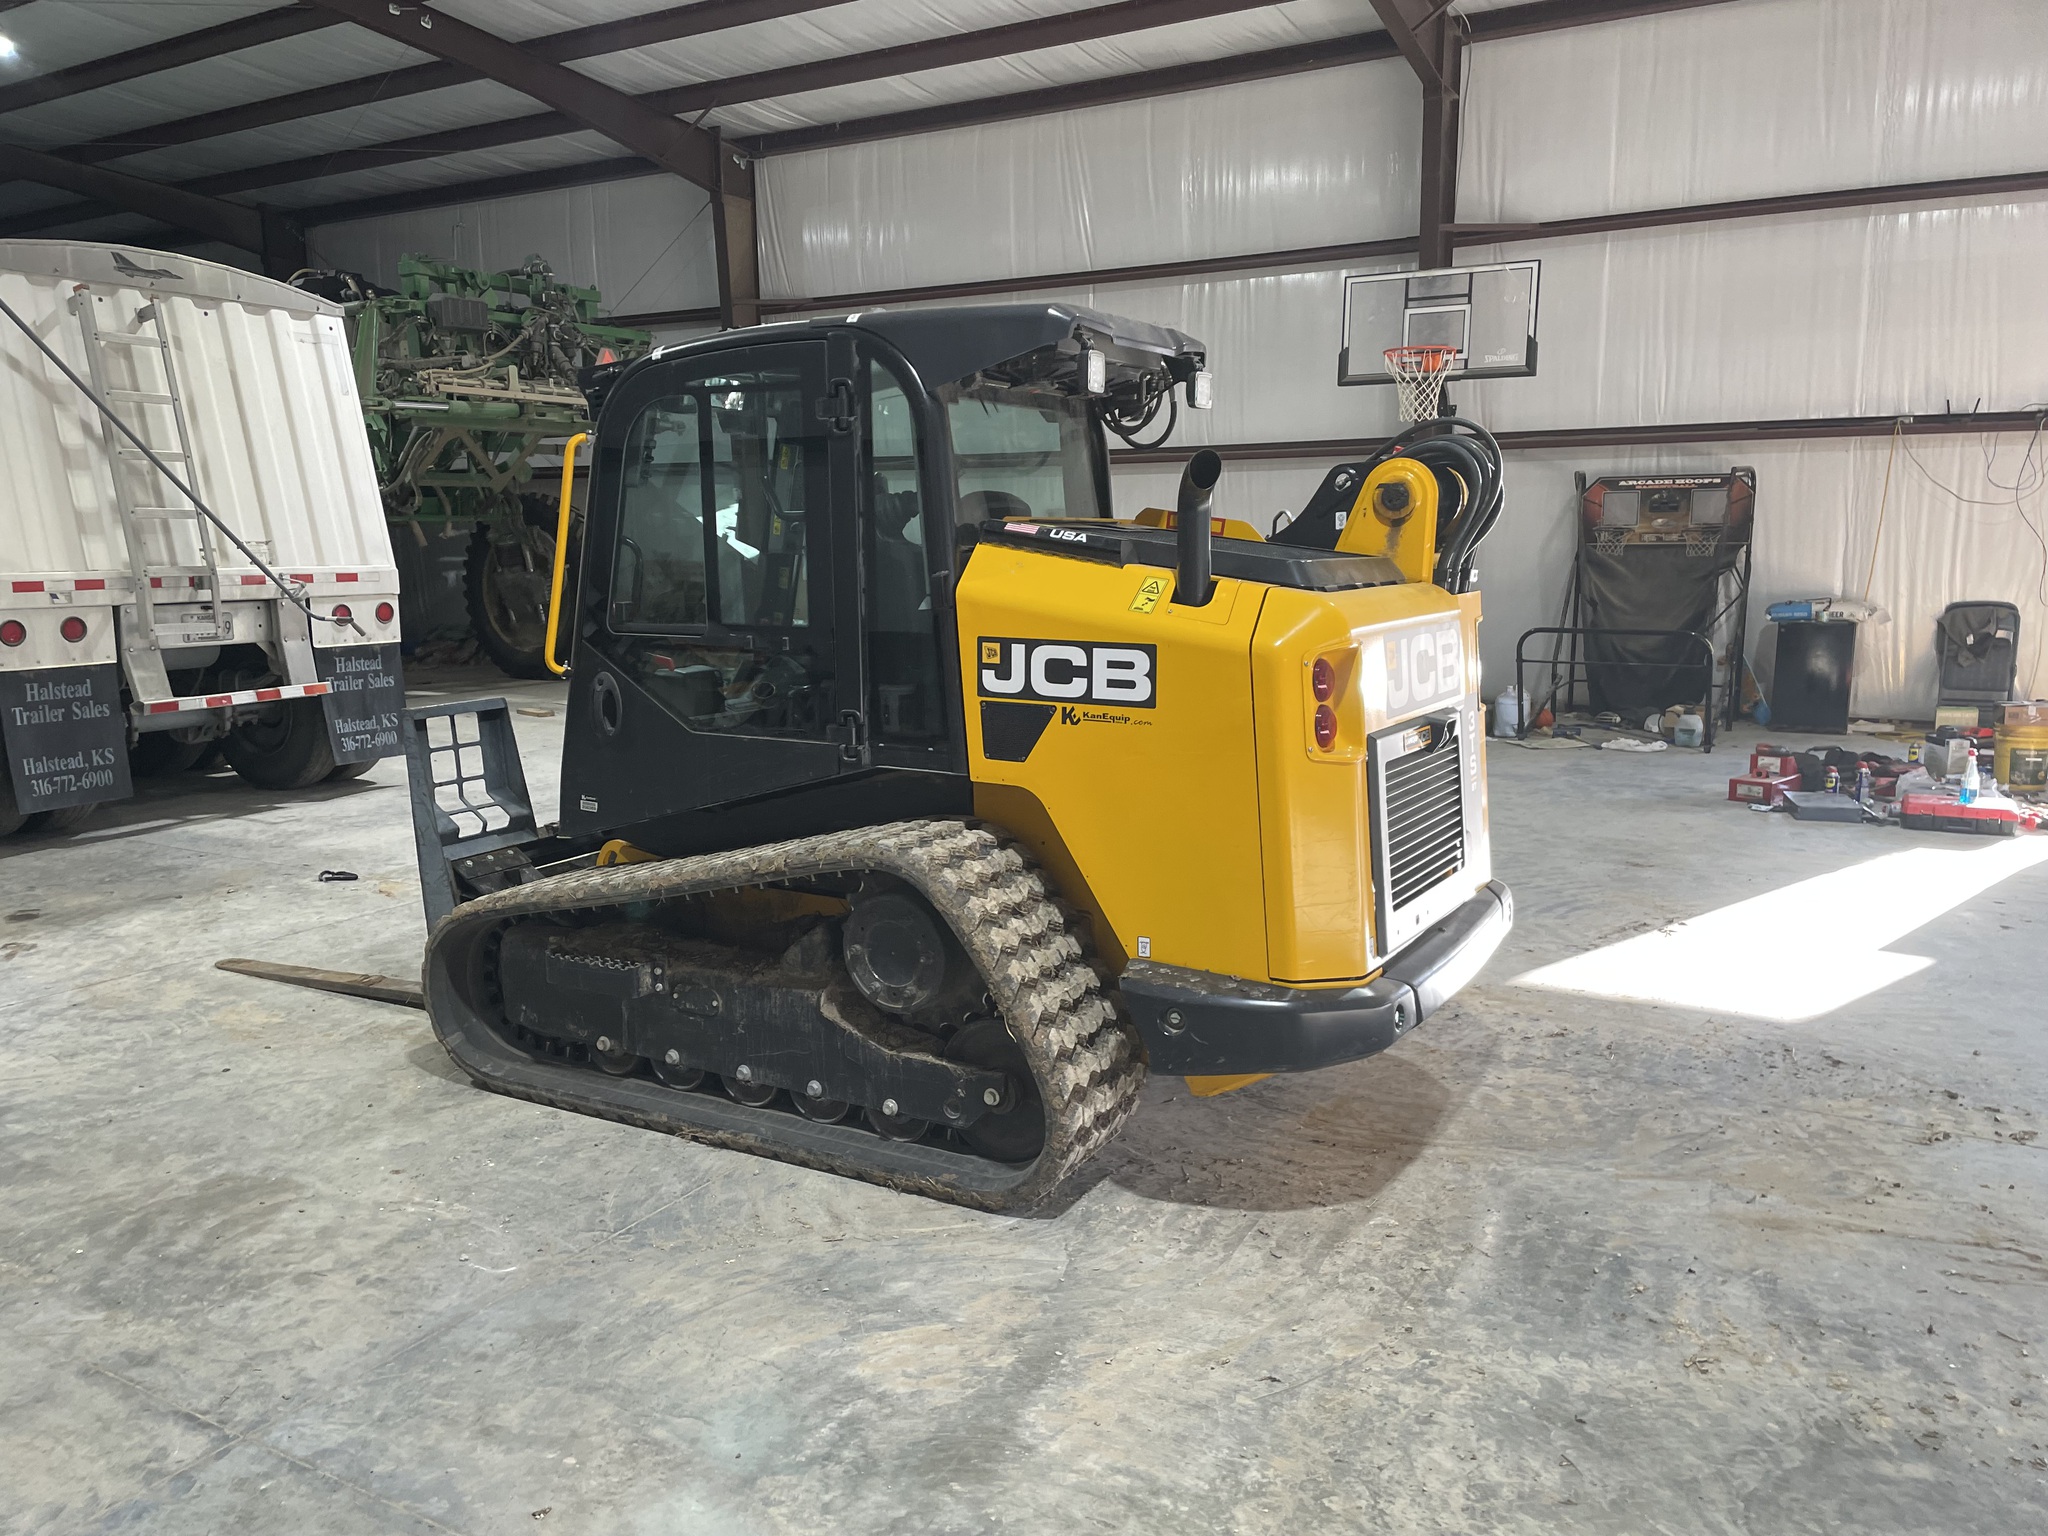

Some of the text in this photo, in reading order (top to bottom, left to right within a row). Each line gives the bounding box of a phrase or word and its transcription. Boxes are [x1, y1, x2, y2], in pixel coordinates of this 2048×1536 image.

[1484, 353, 1519, 364] SPALDING
[1619, 478, 1722, 487] ARCADE HOOPS
[1050, 529, 1087, 543] USA
[333, 654, 382, 673] Halstead
[981, 643, 1152, 702] JCB
[1387, 628, 1461, 709] JCB
[25, 678, 92, 702] Halstead
[367, 672, 395, 689] Sales
[11, 700, 111, 726] Trailer Sales
[334, 712, 398, 734] Halstead, KS
[340, 730, 398, 752] 316-772-6900
[22, 747, 115, 776] Halstead, KS
[31, 768, 114, 798] 316-772-6900
